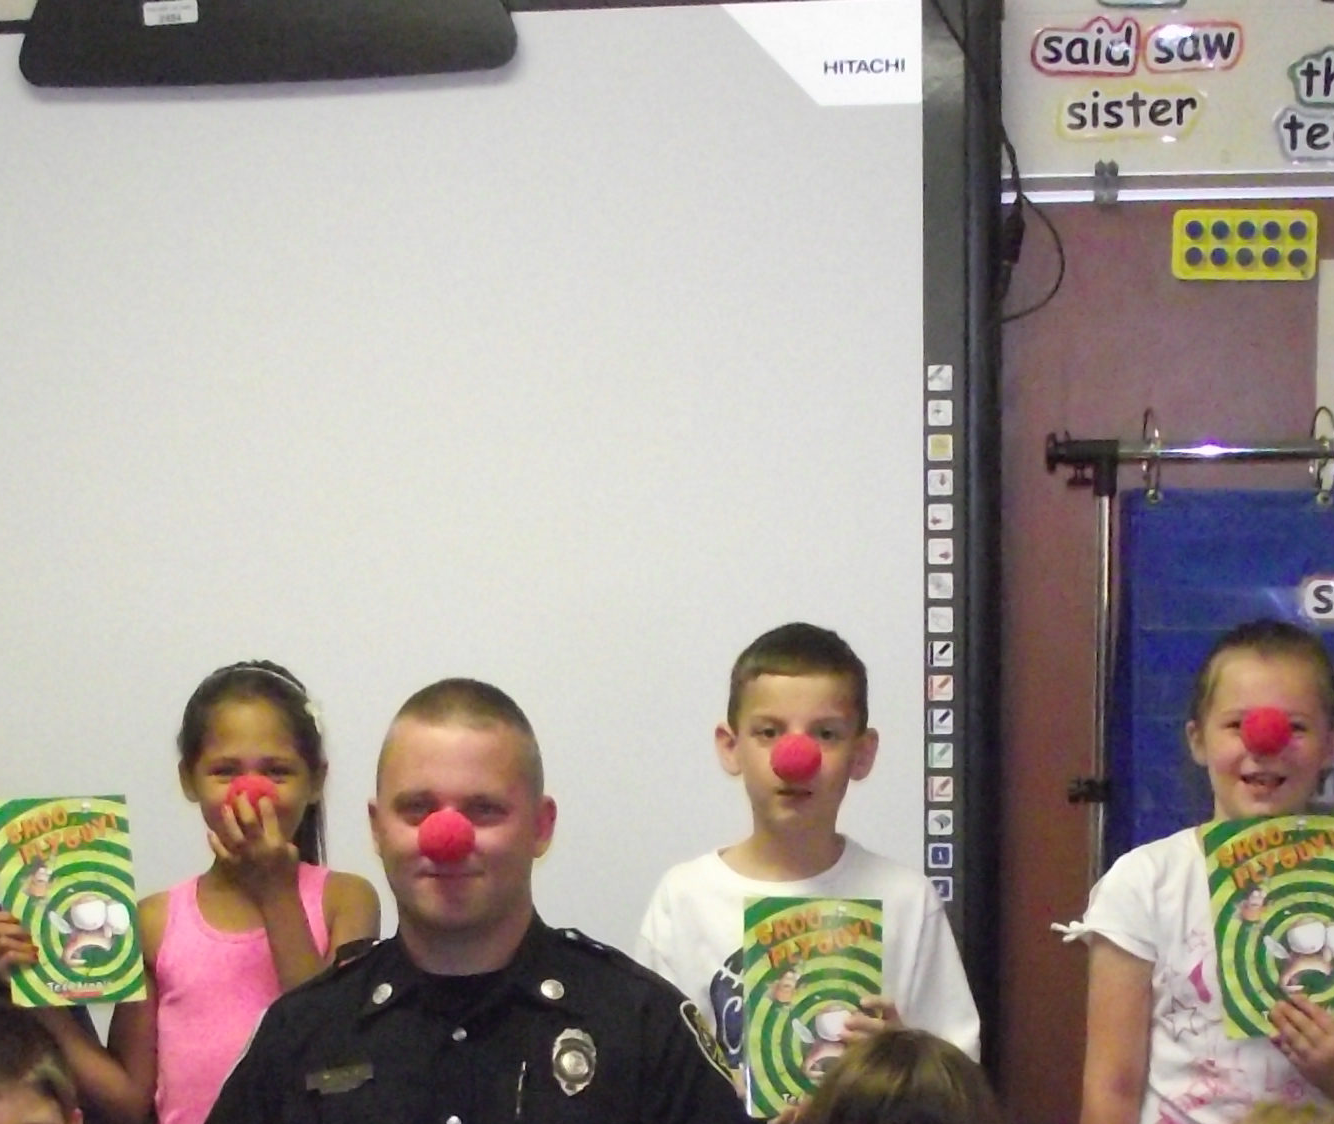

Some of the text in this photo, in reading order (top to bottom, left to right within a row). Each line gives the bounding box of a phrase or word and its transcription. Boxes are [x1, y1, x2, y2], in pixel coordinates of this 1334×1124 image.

[1042, 27, 1133, 66] said
[1153, 30, 1236, 63] saw
[823, 58, 906, 76] HITACHI
[1067, 91, 1197, 131] sister
